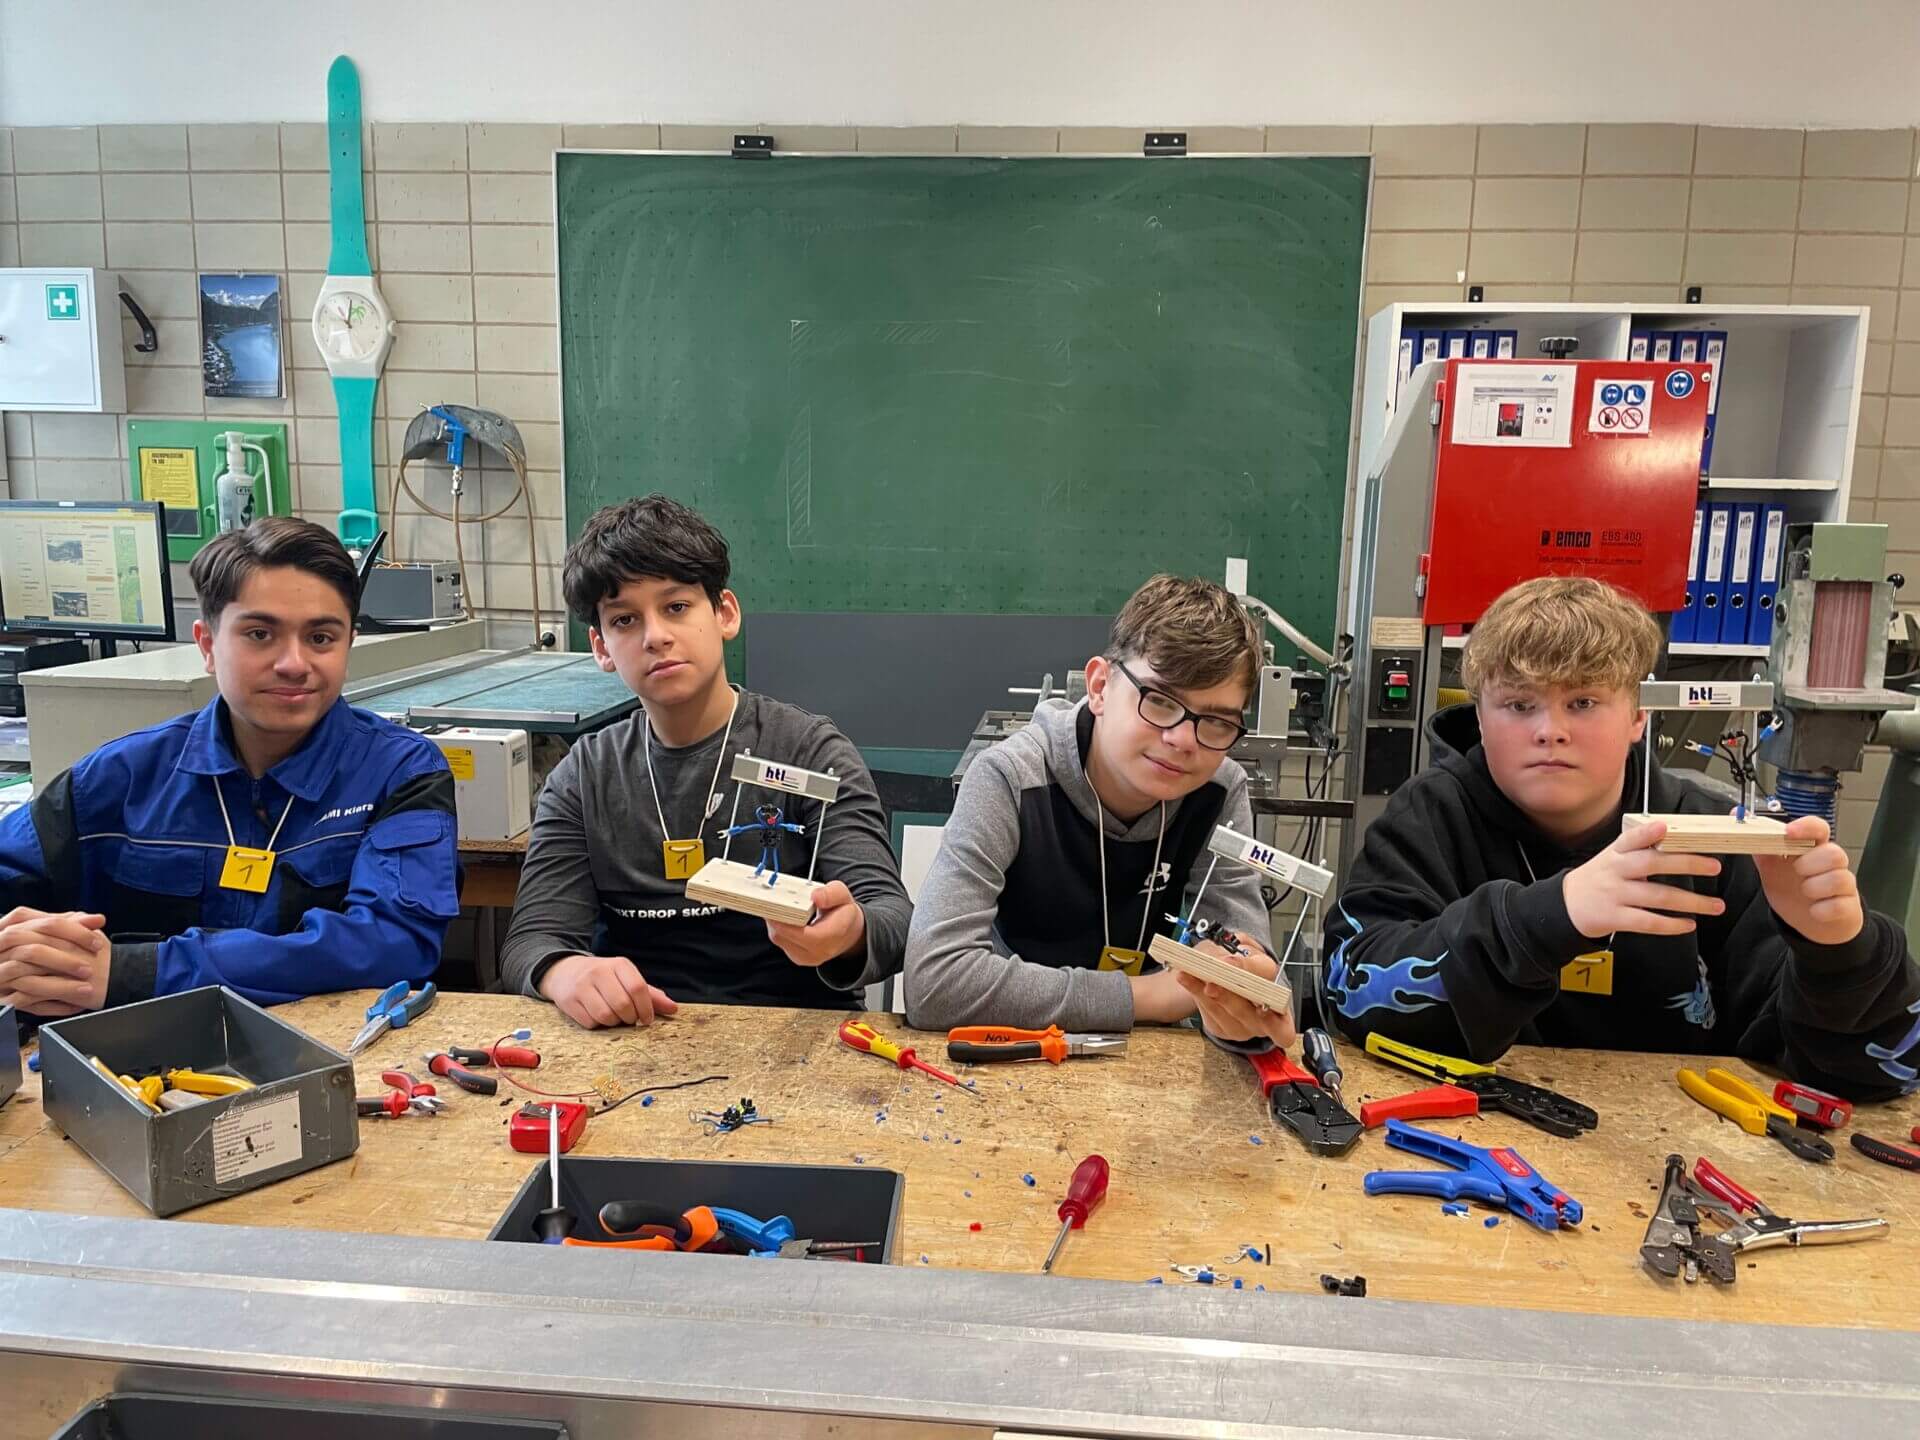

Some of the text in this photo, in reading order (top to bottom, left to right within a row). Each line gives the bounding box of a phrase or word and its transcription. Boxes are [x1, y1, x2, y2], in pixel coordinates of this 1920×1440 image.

[1601, 530, 1642, 542] EBS 400
[1689, 686, 1713, 701] htl
[765, 765, 787, 782] htl
[677, 853, 688, 873] 1
[1249, 845, 1275, 866] htl
[238, 863, 254, 885] 1
[637, 908, 677, 919] DROP
[1576, 966, 1591, 988] 1
